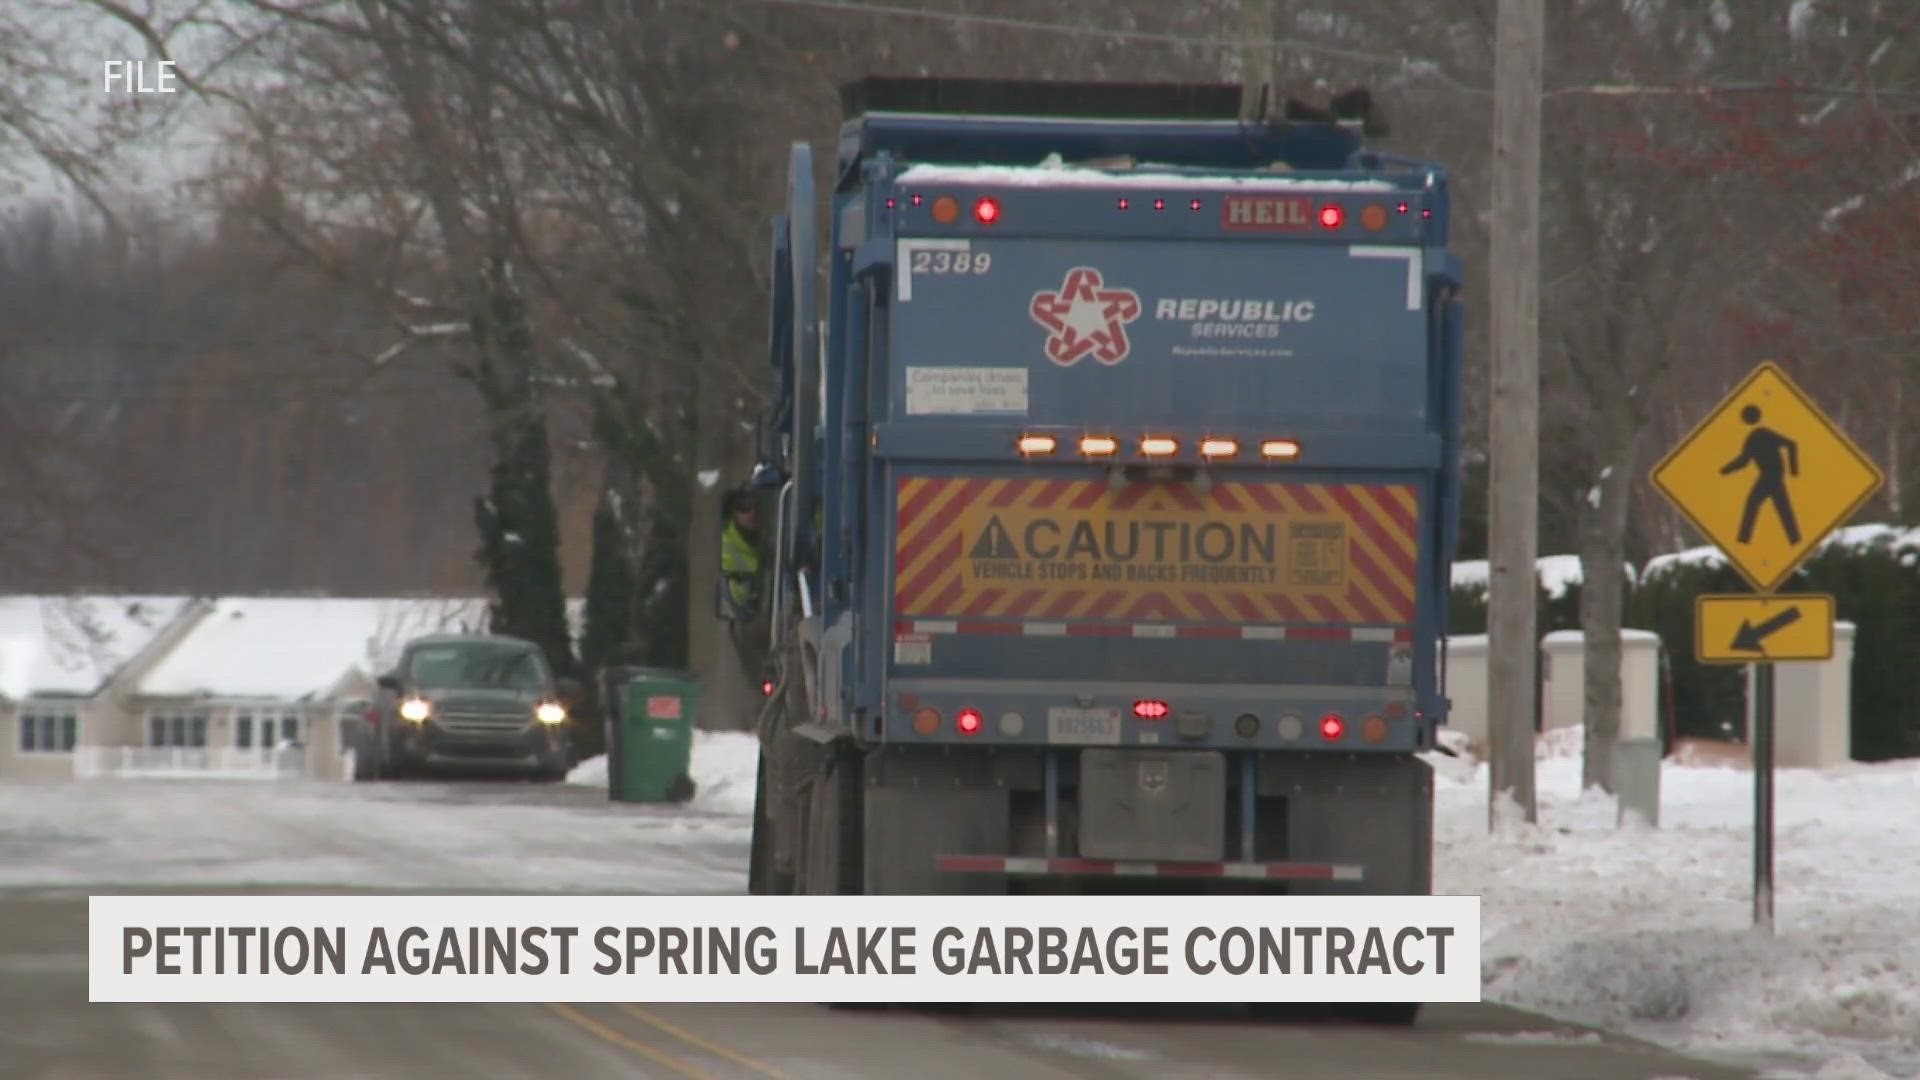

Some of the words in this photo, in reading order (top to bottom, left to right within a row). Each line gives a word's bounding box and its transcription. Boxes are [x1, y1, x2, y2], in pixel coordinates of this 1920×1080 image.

[1228, 201, 1307, 226] HEIL
[912, 252, 992, 274] 2389
[1155, 298, 1315, 322] REPUBLIC
[1191, 323, 1279, 338] SERVICES
[1023, 516, 1276, 563] CAUTION
[972, 560, 1034, 579] VEHICLE
[1038, 561, 1088, 580] STOPS
[1091, 563, 1123, 581] AND
[1127, 563, 1177, 582] BACKS
[1182, 563, 1277, 584] FREQUENTLY
